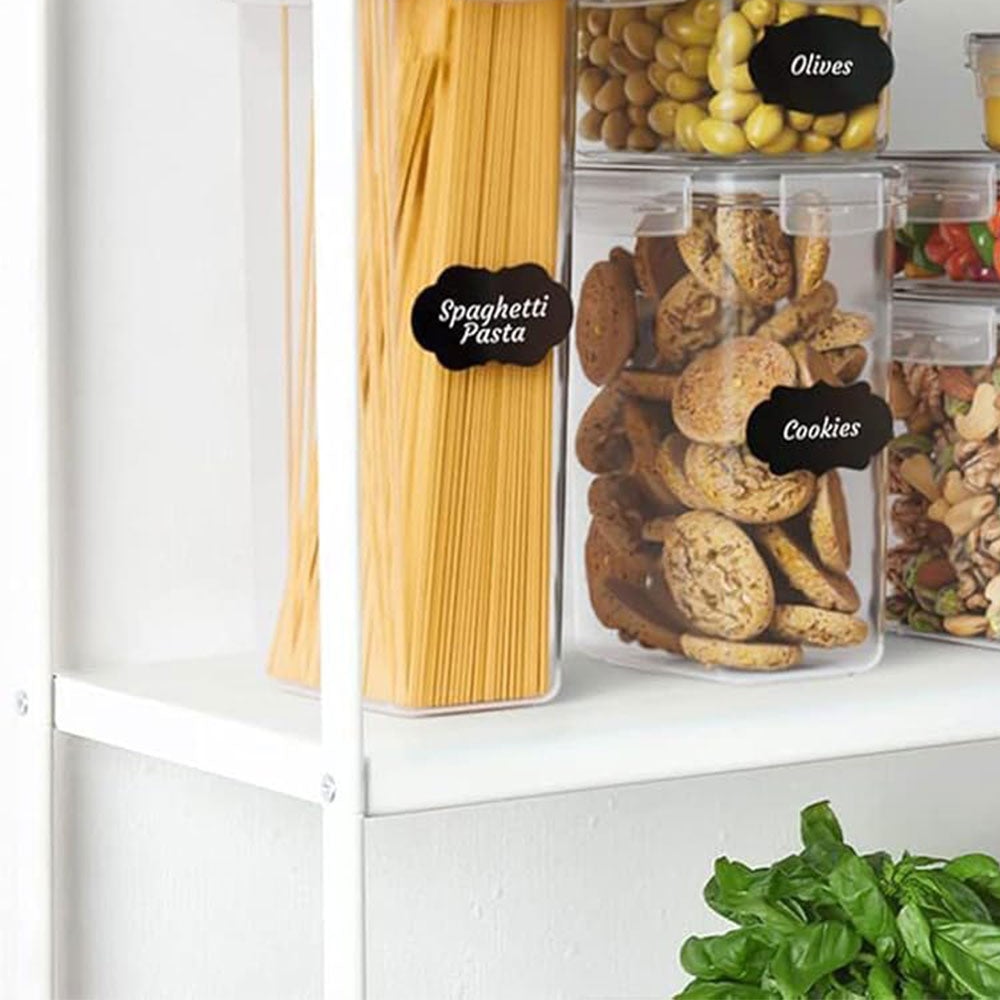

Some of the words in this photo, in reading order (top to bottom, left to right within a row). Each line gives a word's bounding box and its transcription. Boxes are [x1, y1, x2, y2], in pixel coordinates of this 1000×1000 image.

[790, 52, 854, 76] Olives
[438, 294, 550, 329] Spaghetti
[459, 321, 526, 345] Pasta
[783, 415, 862, 441] Cookies
